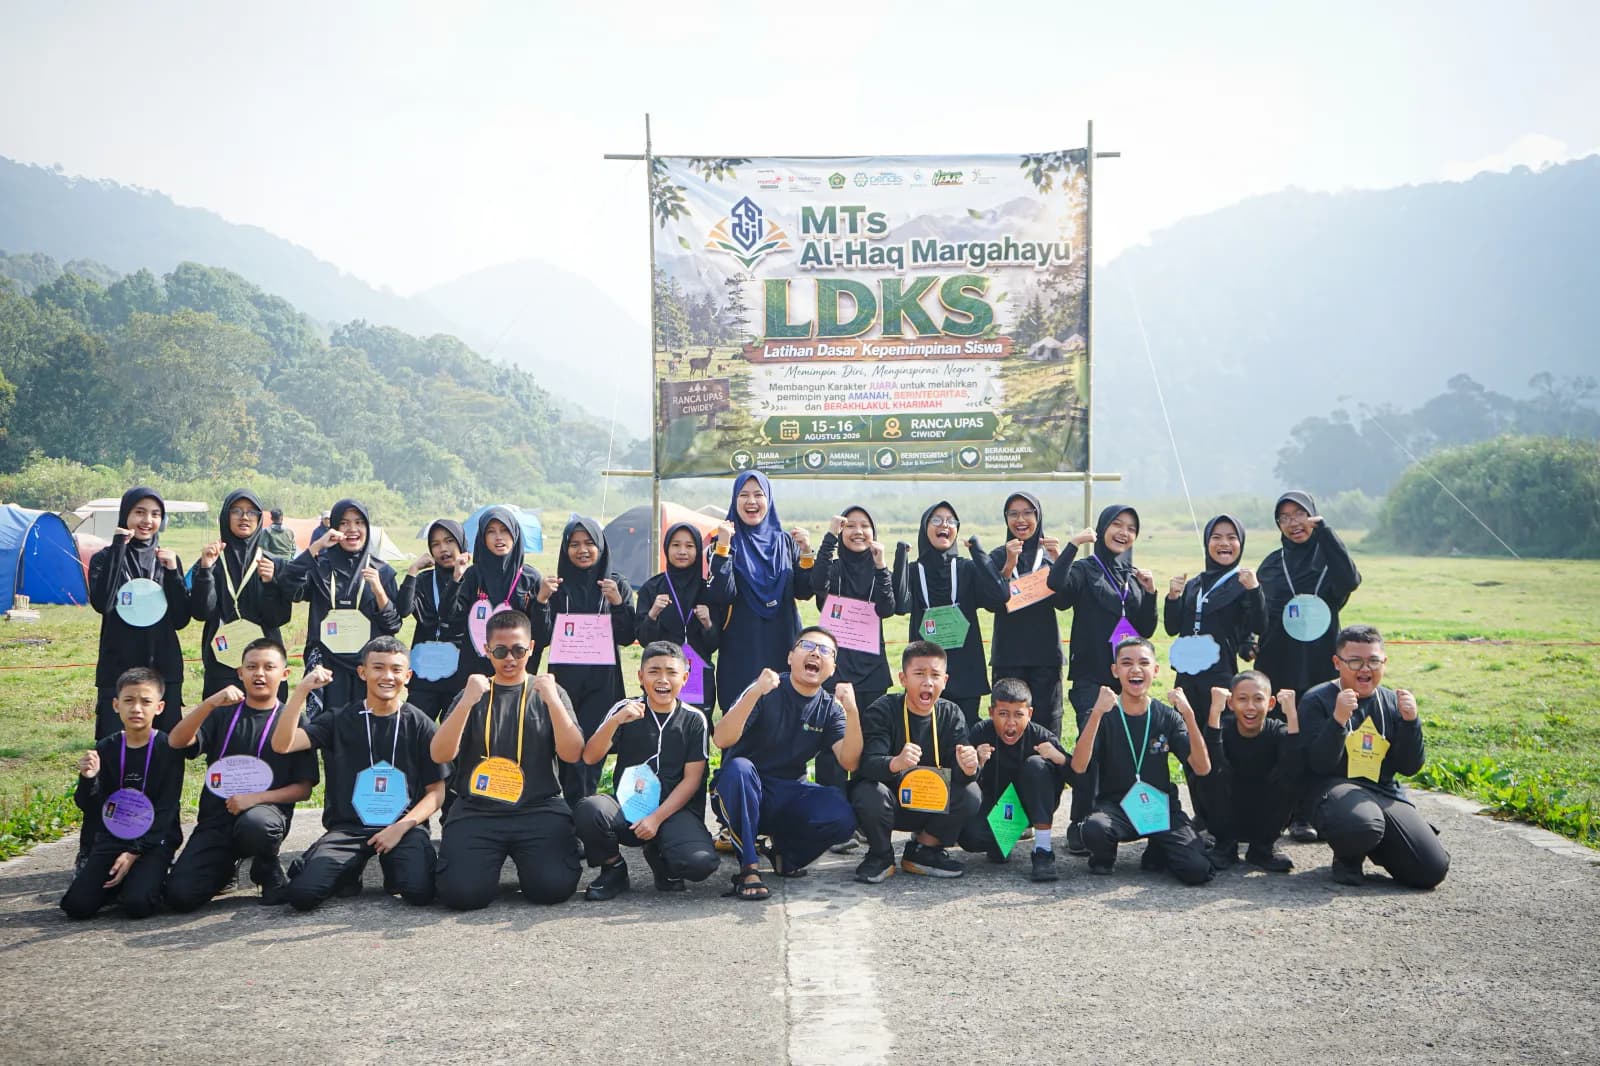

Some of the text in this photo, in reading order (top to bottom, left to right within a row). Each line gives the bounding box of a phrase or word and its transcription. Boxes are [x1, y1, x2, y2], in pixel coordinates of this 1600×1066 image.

[800, 205, 888, 234] MTs
[799, 236, 1072, 268] Al-Haq Margahayu
[762, 274, 995, 340] LDKS
[763, 341, 1002, 358] Latihan Dasar Kepemimpinan Siswa
[769, 379, 978, 393] Membangun Karakter JUARA untuk melahirkan
[672, 392, 724, 405] RANCA UPAS
[777, 393, 822, 402] pemimpin
[823, 393, 846, 402] yang
[682, 403, 714, 414] CIWIDEY
[804, 400, 943, 411] dan BERAKHLAKUL KHARIMAH
[911, 417, 984, 429] RANCA UPAS
[804, 433, 841, 441] AGUSTUS
[911, 430, 947, 438] CIWIDEY
[756, 452, 780, 460] JUARA
[829, 452, 861, 460] AMANAH
